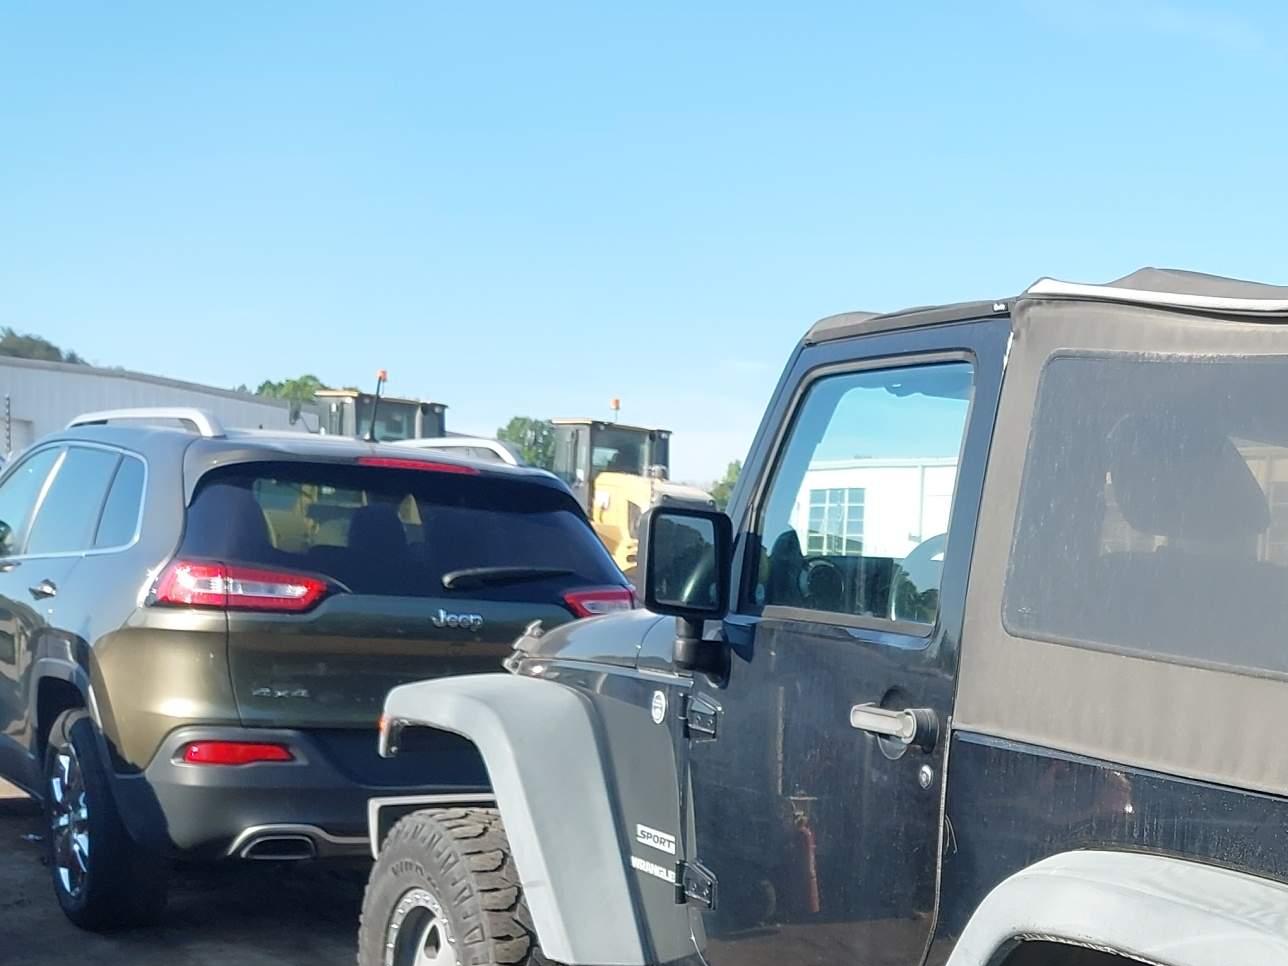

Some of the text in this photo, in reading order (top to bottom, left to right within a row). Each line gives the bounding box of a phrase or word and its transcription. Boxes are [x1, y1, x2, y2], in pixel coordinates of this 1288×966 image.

[430, 608, 484, 632] Jeep
[636, 828, 676, 850] SPORT
[631, 855, 676, 883] WRANGLE
